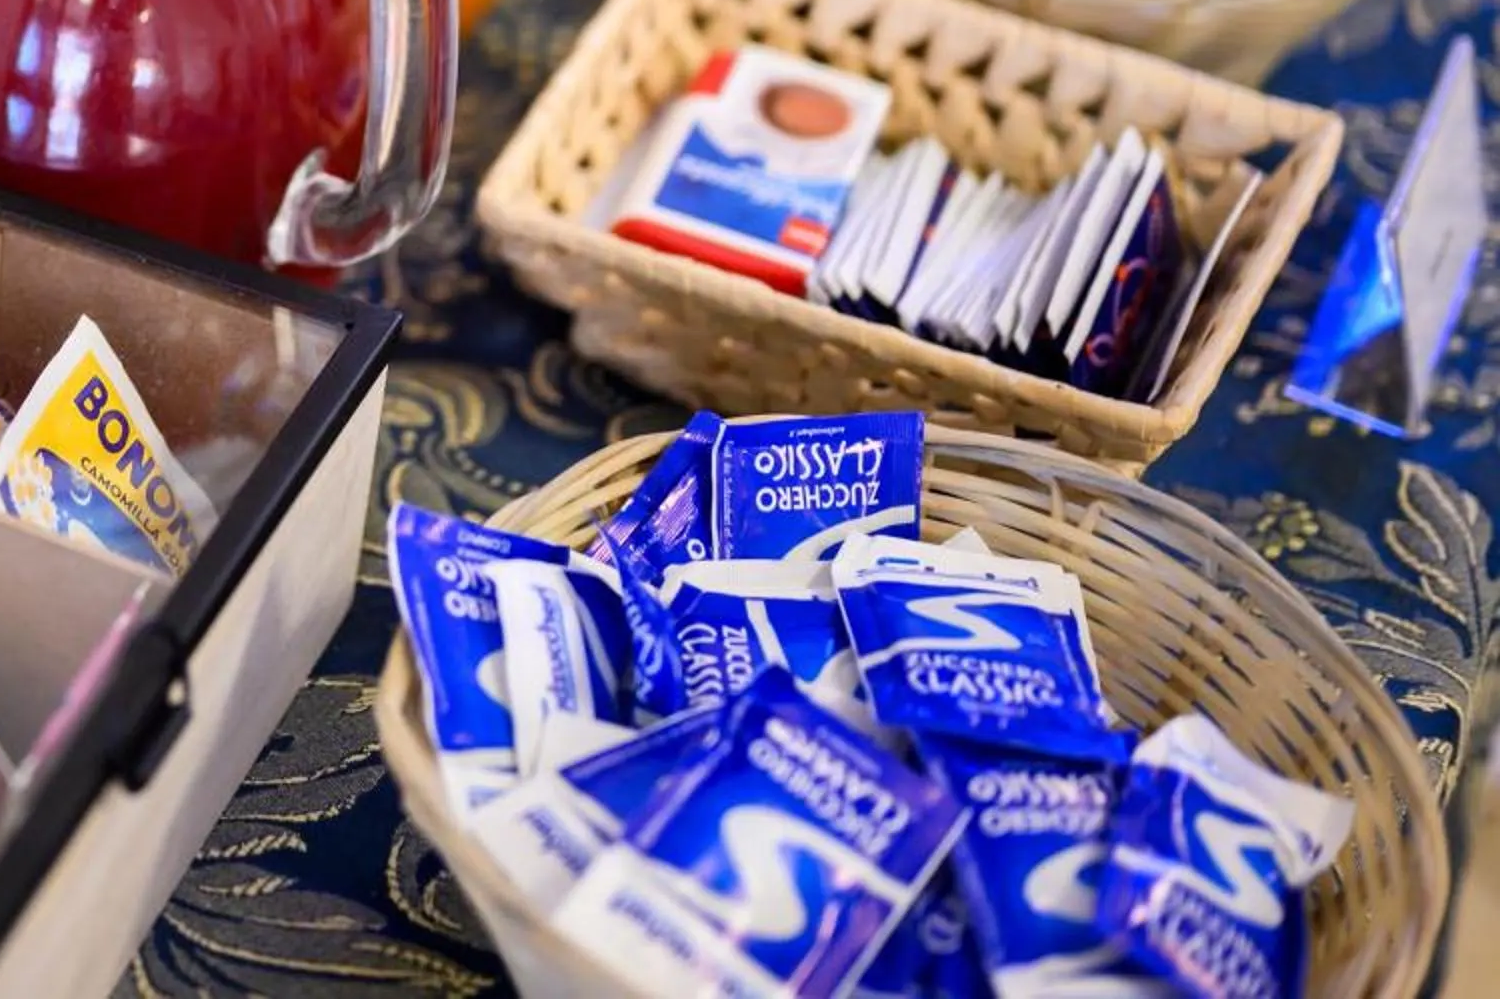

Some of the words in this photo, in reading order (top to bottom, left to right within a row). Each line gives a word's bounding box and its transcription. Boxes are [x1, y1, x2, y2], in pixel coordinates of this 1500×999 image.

[754, 435, 888, 481] CLASSICO
[79, 455, 164, 543] CAMOMILLA
[755, 480, 881, 513] ZUCCHERO
[905, 651, 1056, 691] ZUCCHERO
